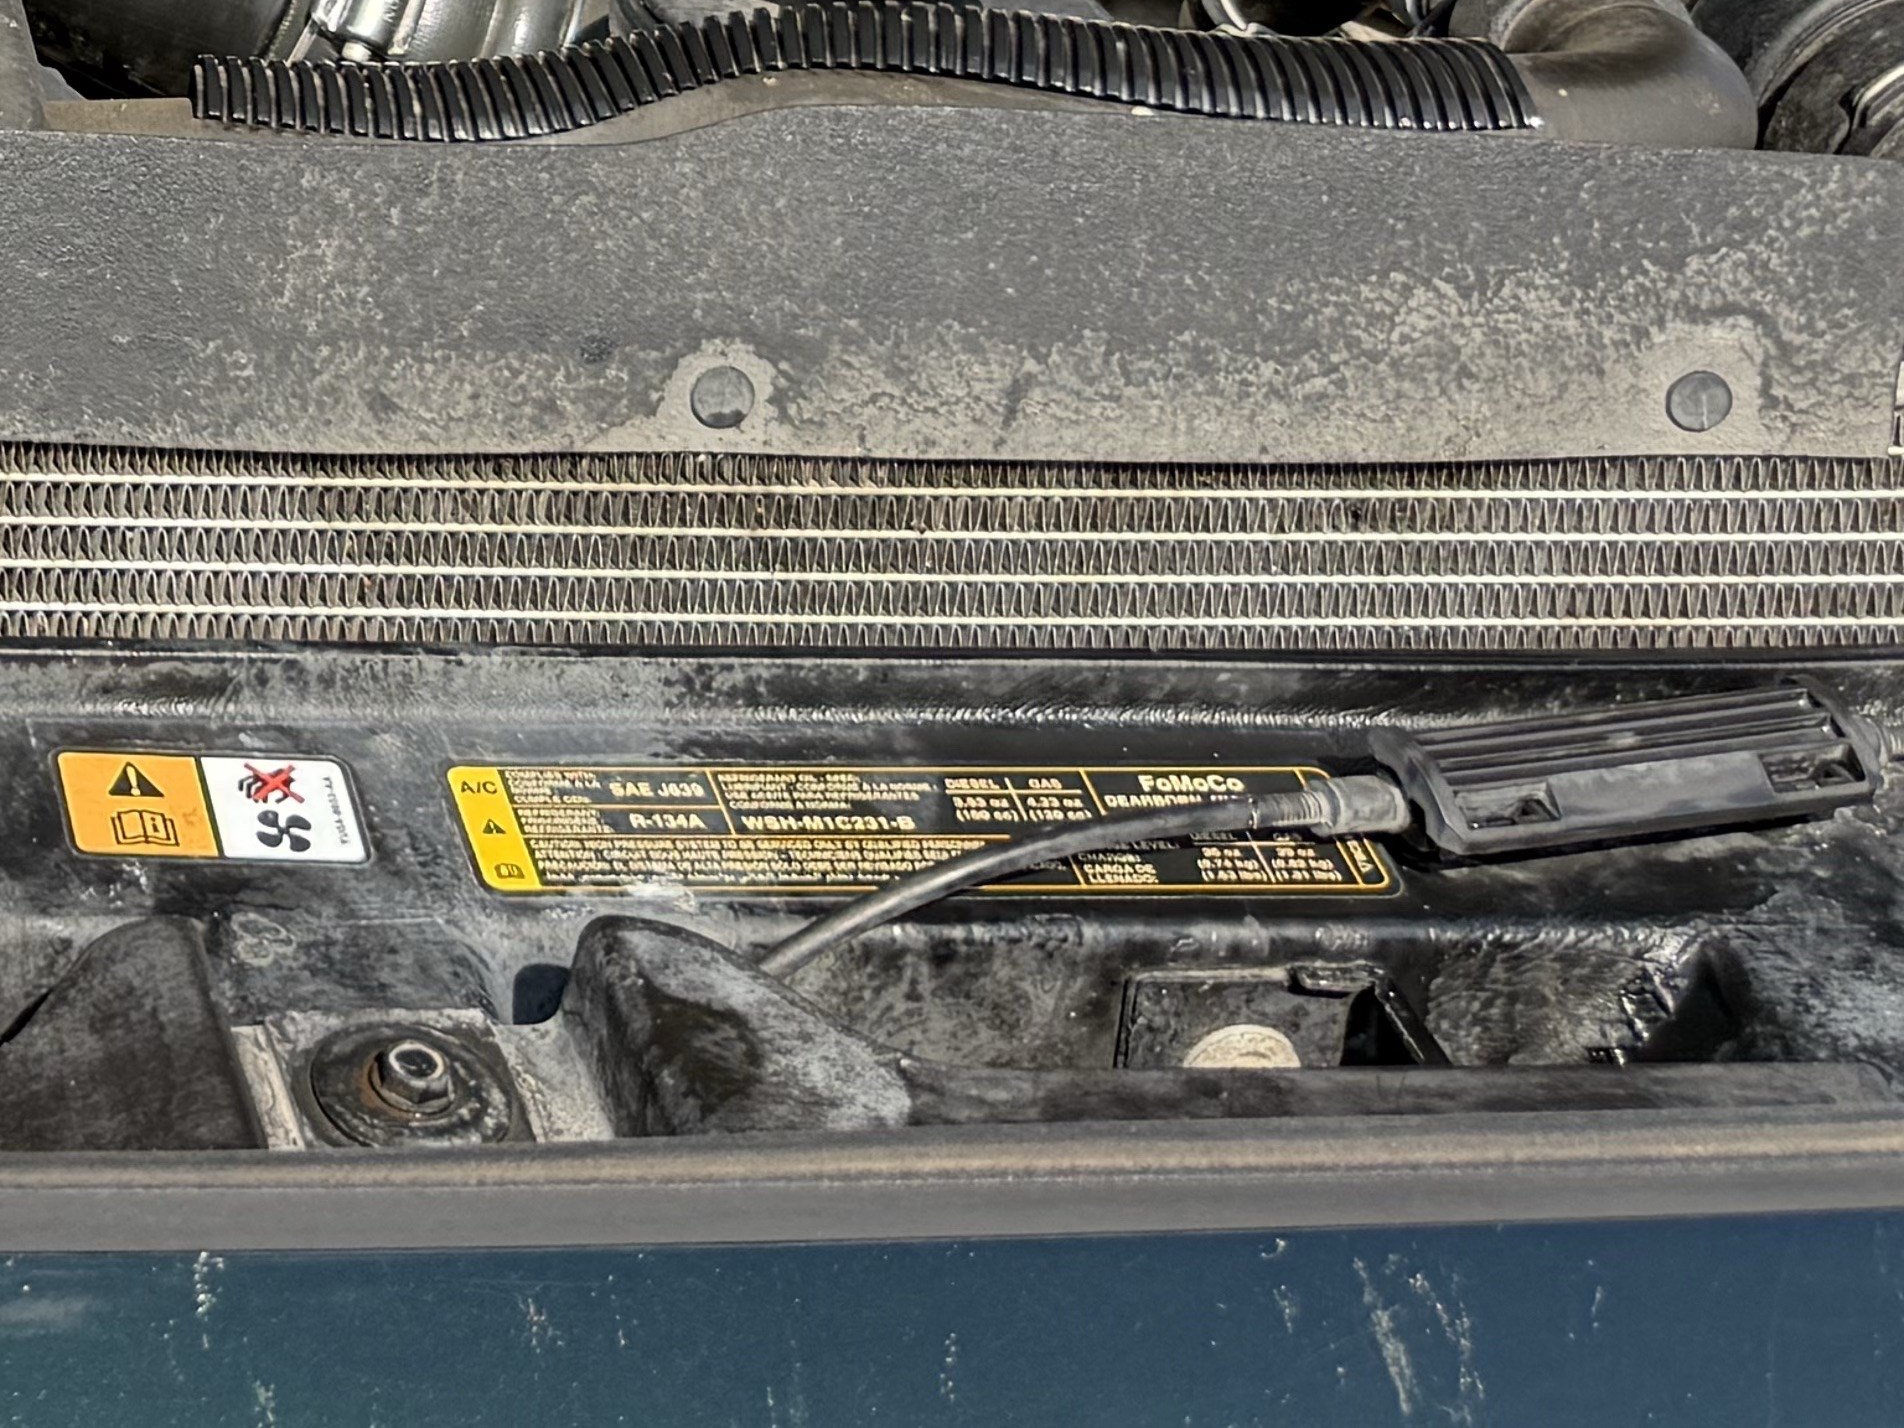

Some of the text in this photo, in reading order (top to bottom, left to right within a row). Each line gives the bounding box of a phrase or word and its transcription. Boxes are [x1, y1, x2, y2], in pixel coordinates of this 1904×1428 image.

[460, 781, 498, 795] A/C
[609, 782, 706, 798] SAE J639
[944, 778, 1062, 789] DIESEL GAS
[1137, 775, 1246, 792] FoMoCo
[629, 813, 708, 830] R-134A
[741, 815, 917, 831] WSH-M1C231-B
